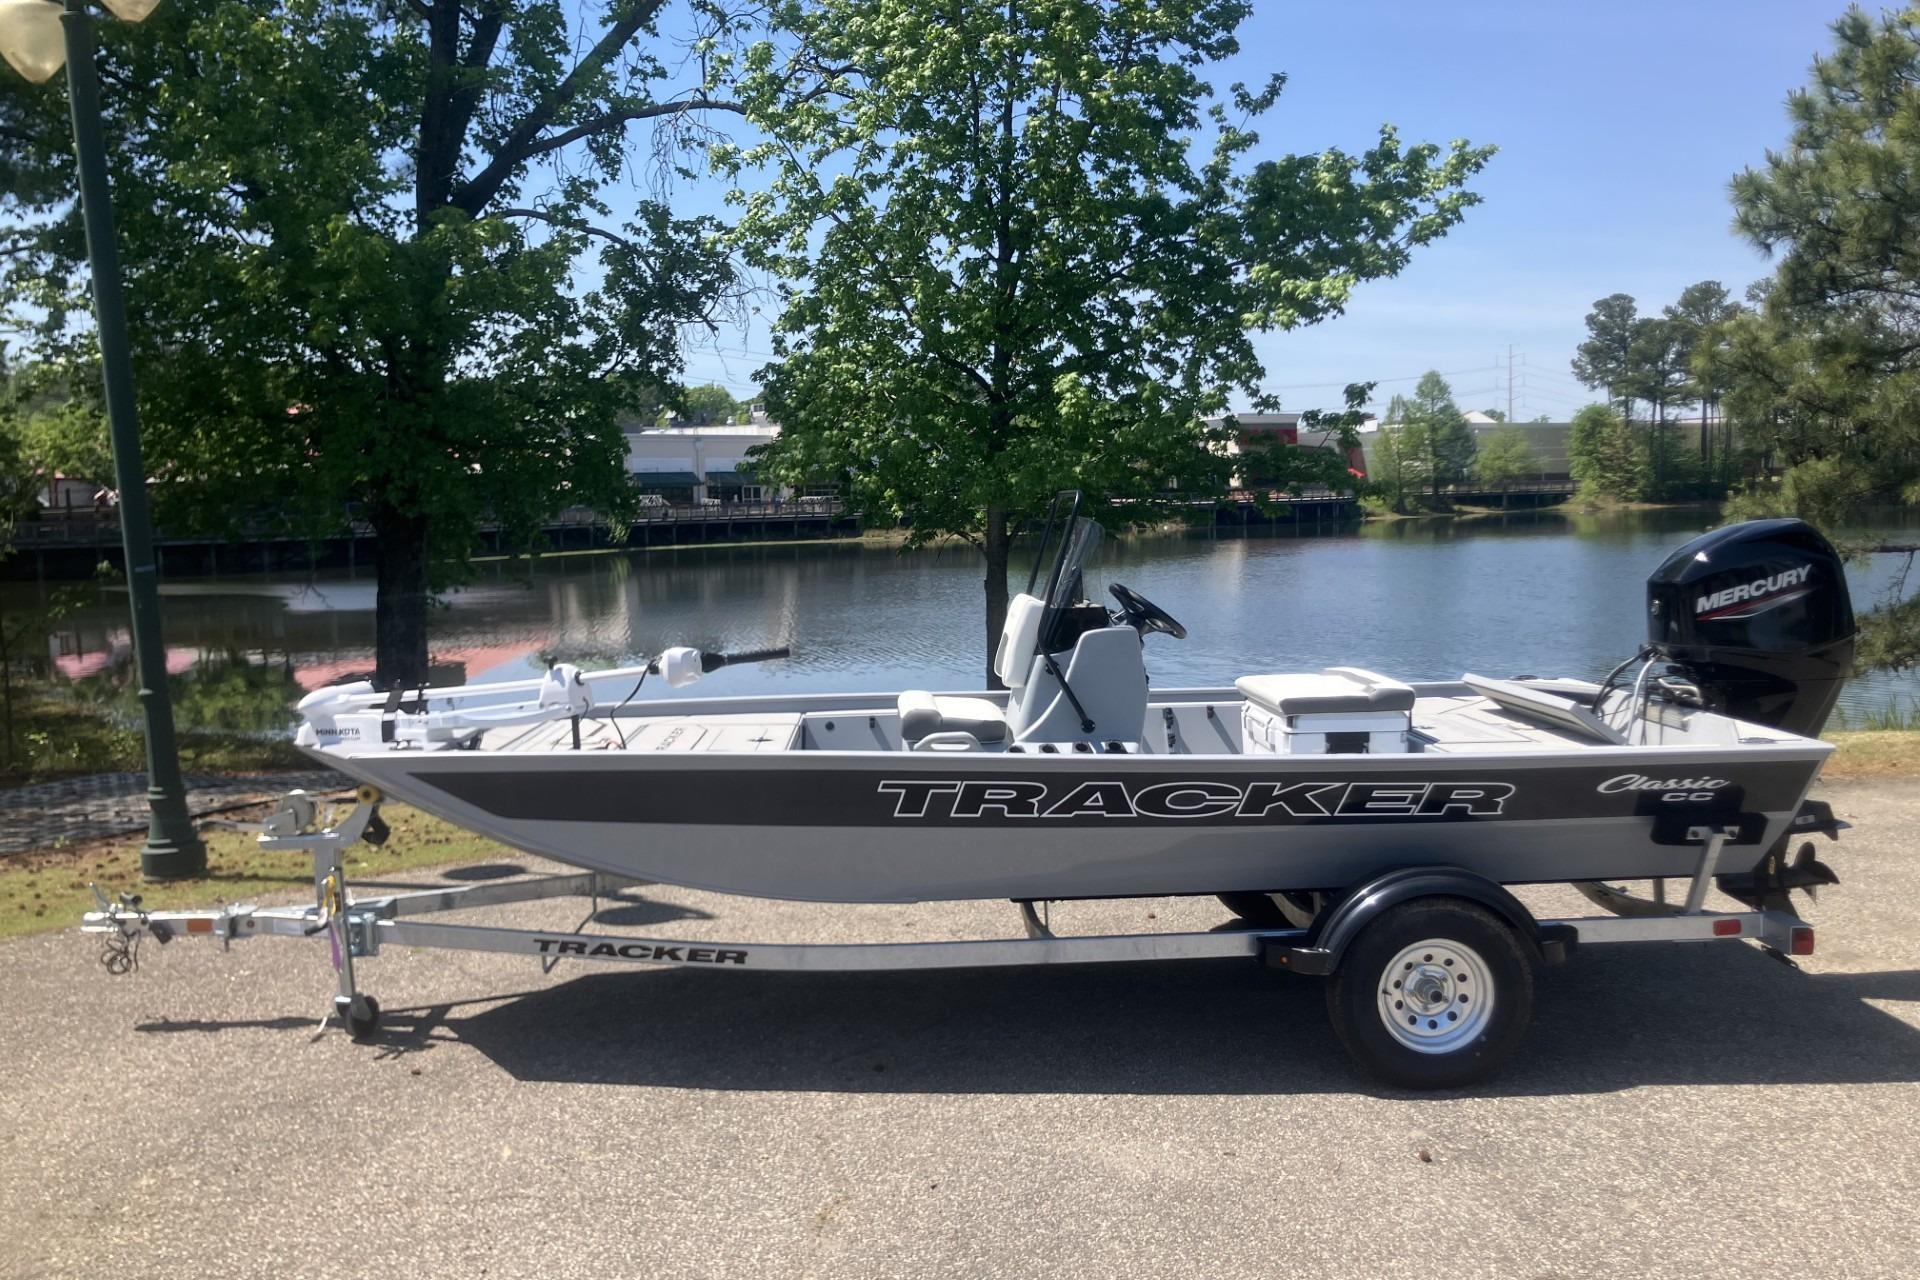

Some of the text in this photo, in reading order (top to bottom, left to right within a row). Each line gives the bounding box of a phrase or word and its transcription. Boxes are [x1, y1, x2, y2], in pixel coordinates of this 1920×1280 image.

[1696, 563, 1812, 613] MERCURY
[315, 727, 361, 737] MINN KOTA
[1596, 773, 1731, 794] Classic
[877, 780, 1516, 818] TRACKER
[1661, 792, 1715, 802] CC
[533, 938, 749, 965] TRACKER
